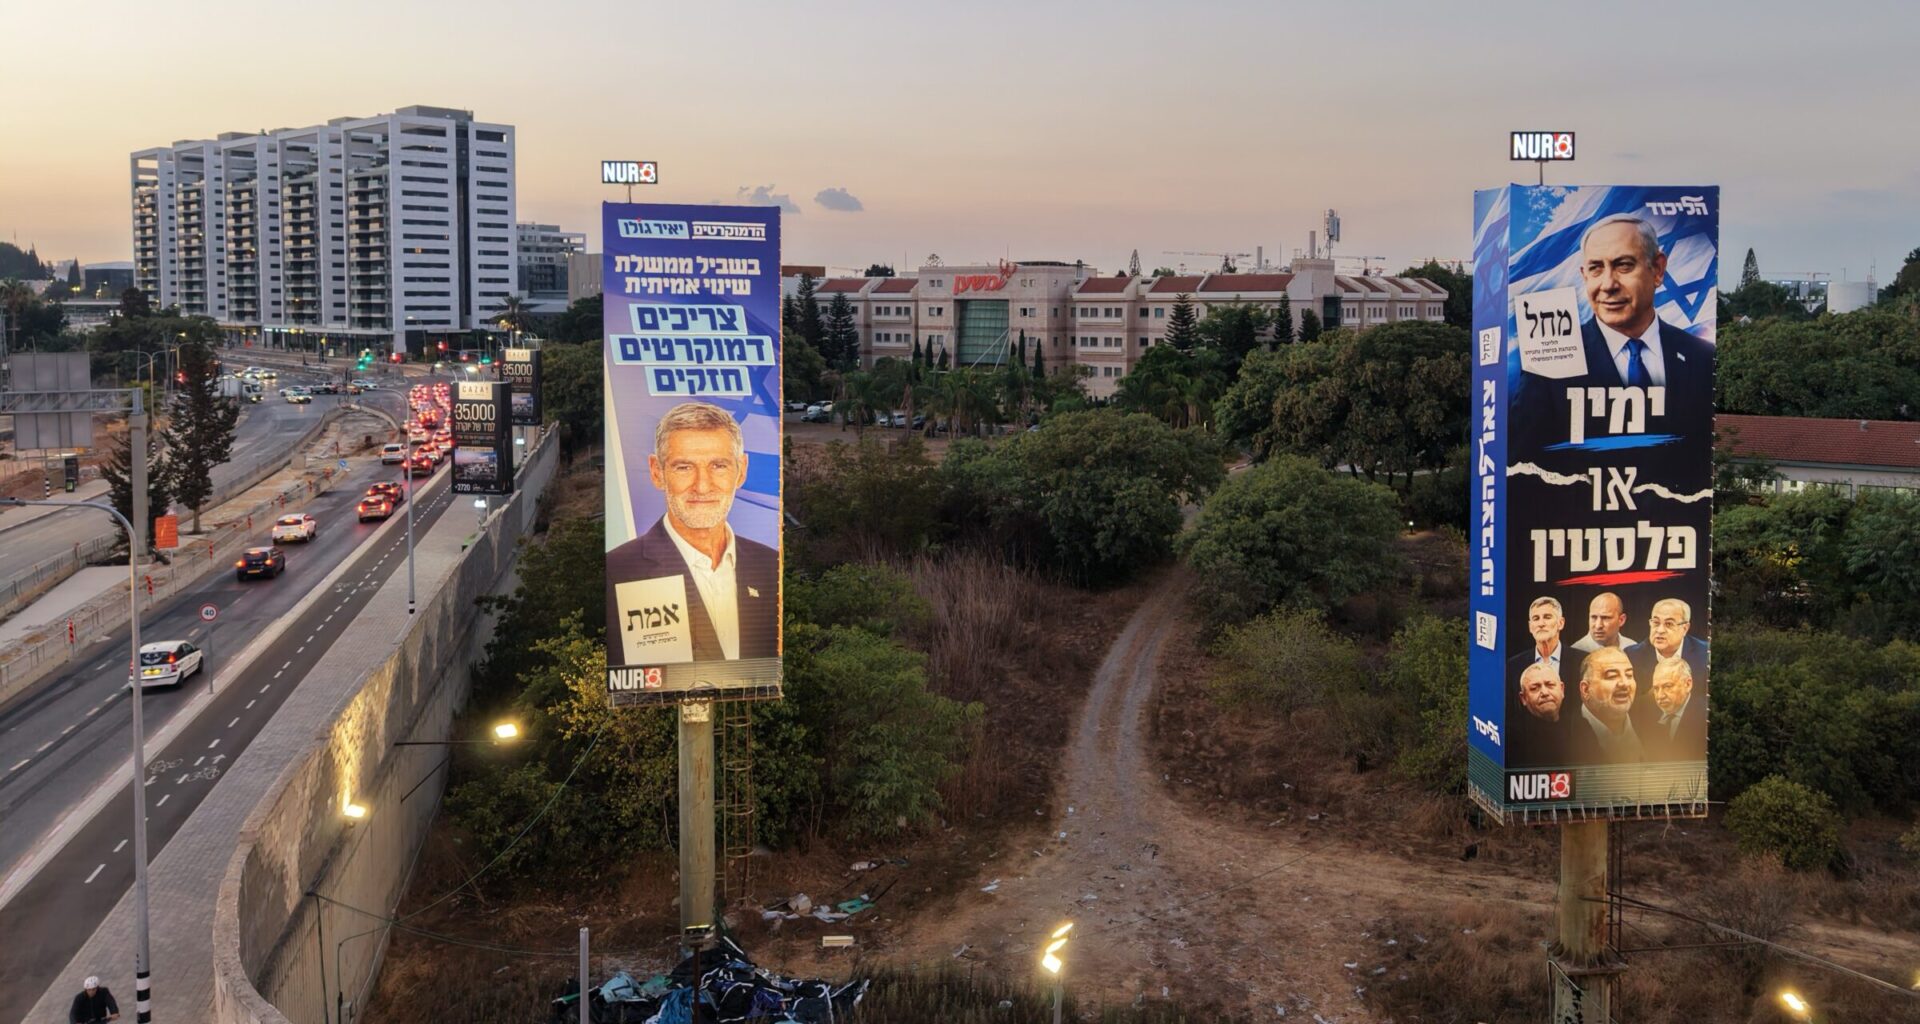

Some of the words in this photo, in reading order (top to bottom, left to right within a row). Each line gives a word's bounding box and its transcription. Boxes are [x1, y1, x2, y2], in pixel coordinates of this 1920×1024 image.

[1645, 195, 1708, 216] הליכוד
[623, 220, 652, 236] גולן
[654, 222, 683, 236] יאיר
[693, 224, 766, 238] הדמוקרטים
[615, 254, 693, 274] ממשלת
[696, 255, 761, 275] בשביל
[625, 276, 700, 294] אמיתית
[703, 278, 751, 296] שינוי
[637, 307, 739, 331] צריכים
[1523, 301, 1573, 339] מחל
[619, 337, 766, 364] דמוקרטים
[654, 368, 743, 395] חזקים
[1483, 380, 1496, 443] צאו
[1566, 386, 1666, 444] ימין
[1588, 466, 1638, 511] או
[1531, 520, 1697, 582] פלסטין
[627, 603, 680, 632] אמת
